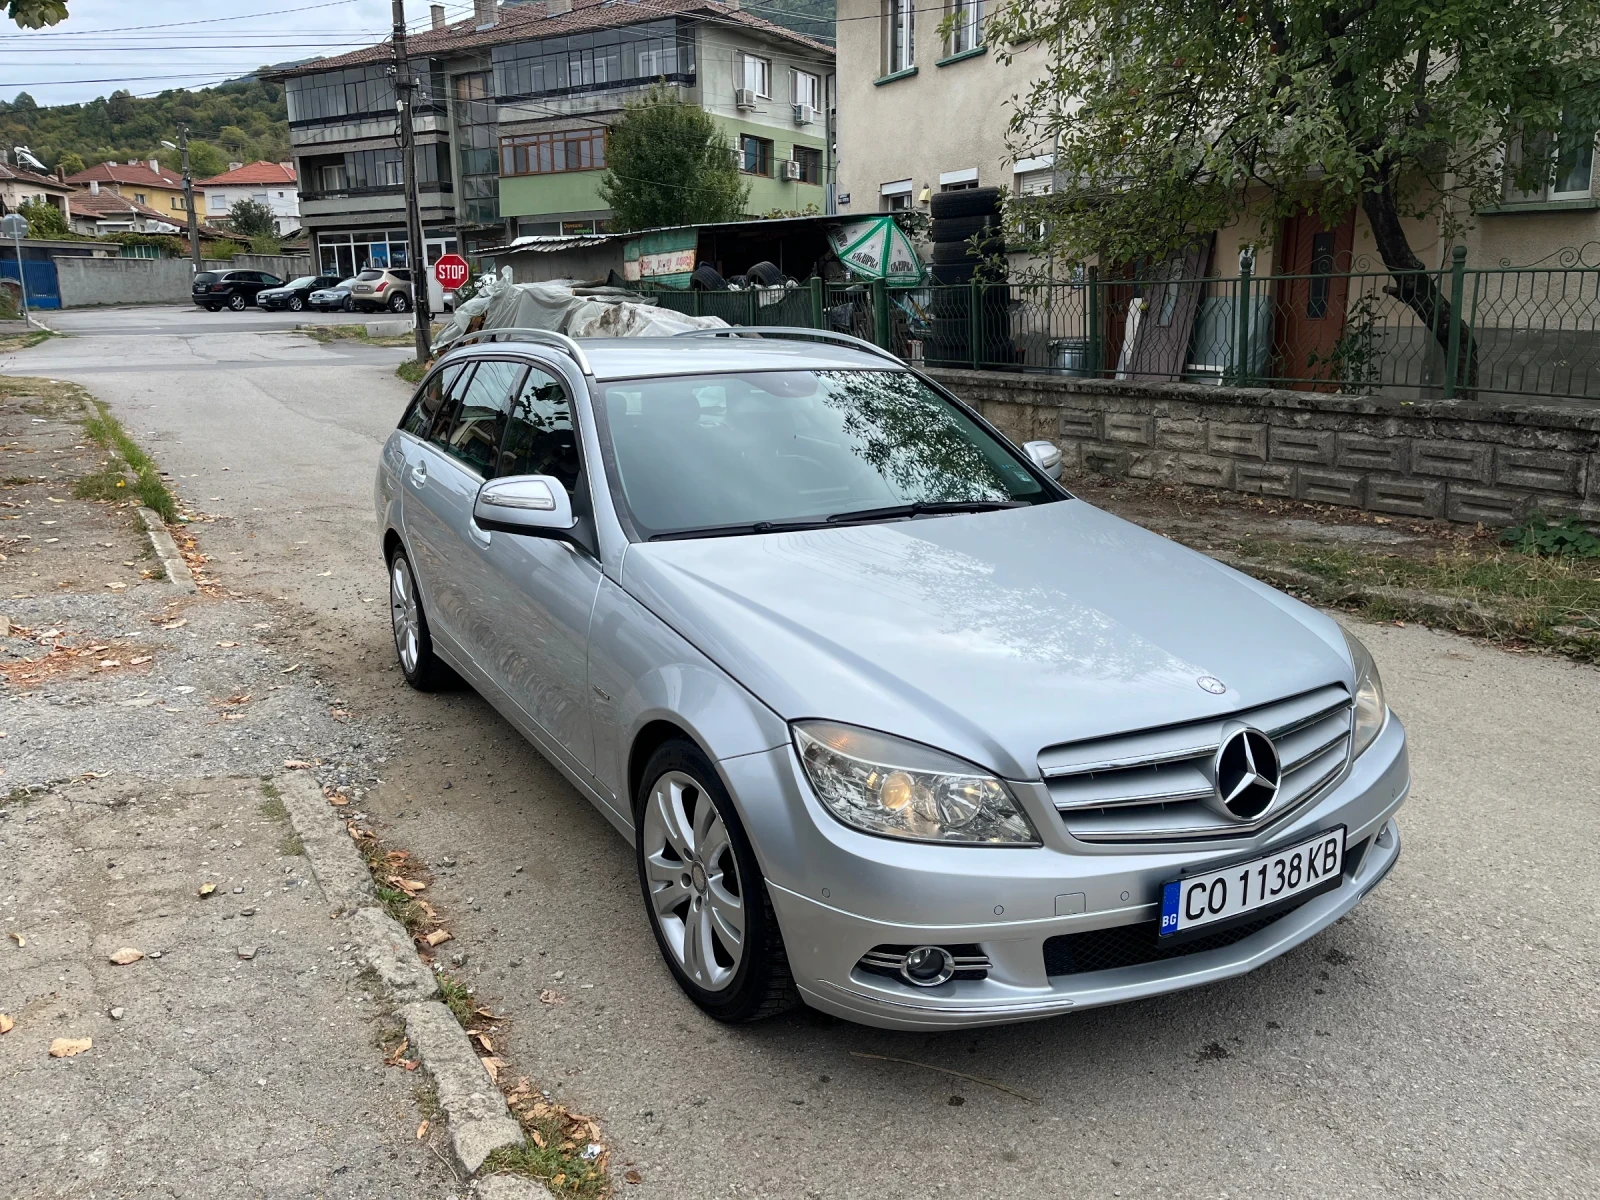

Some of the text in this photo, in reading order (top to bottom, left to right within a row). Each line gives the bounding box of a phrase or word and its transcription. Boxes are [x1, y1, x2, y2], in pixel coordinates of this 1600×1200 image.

[438, 265, 465, 279] STOP
[1185, 837, 1338, 920] CO 1138 KB
[1162, 913, 1177, 927] BG
